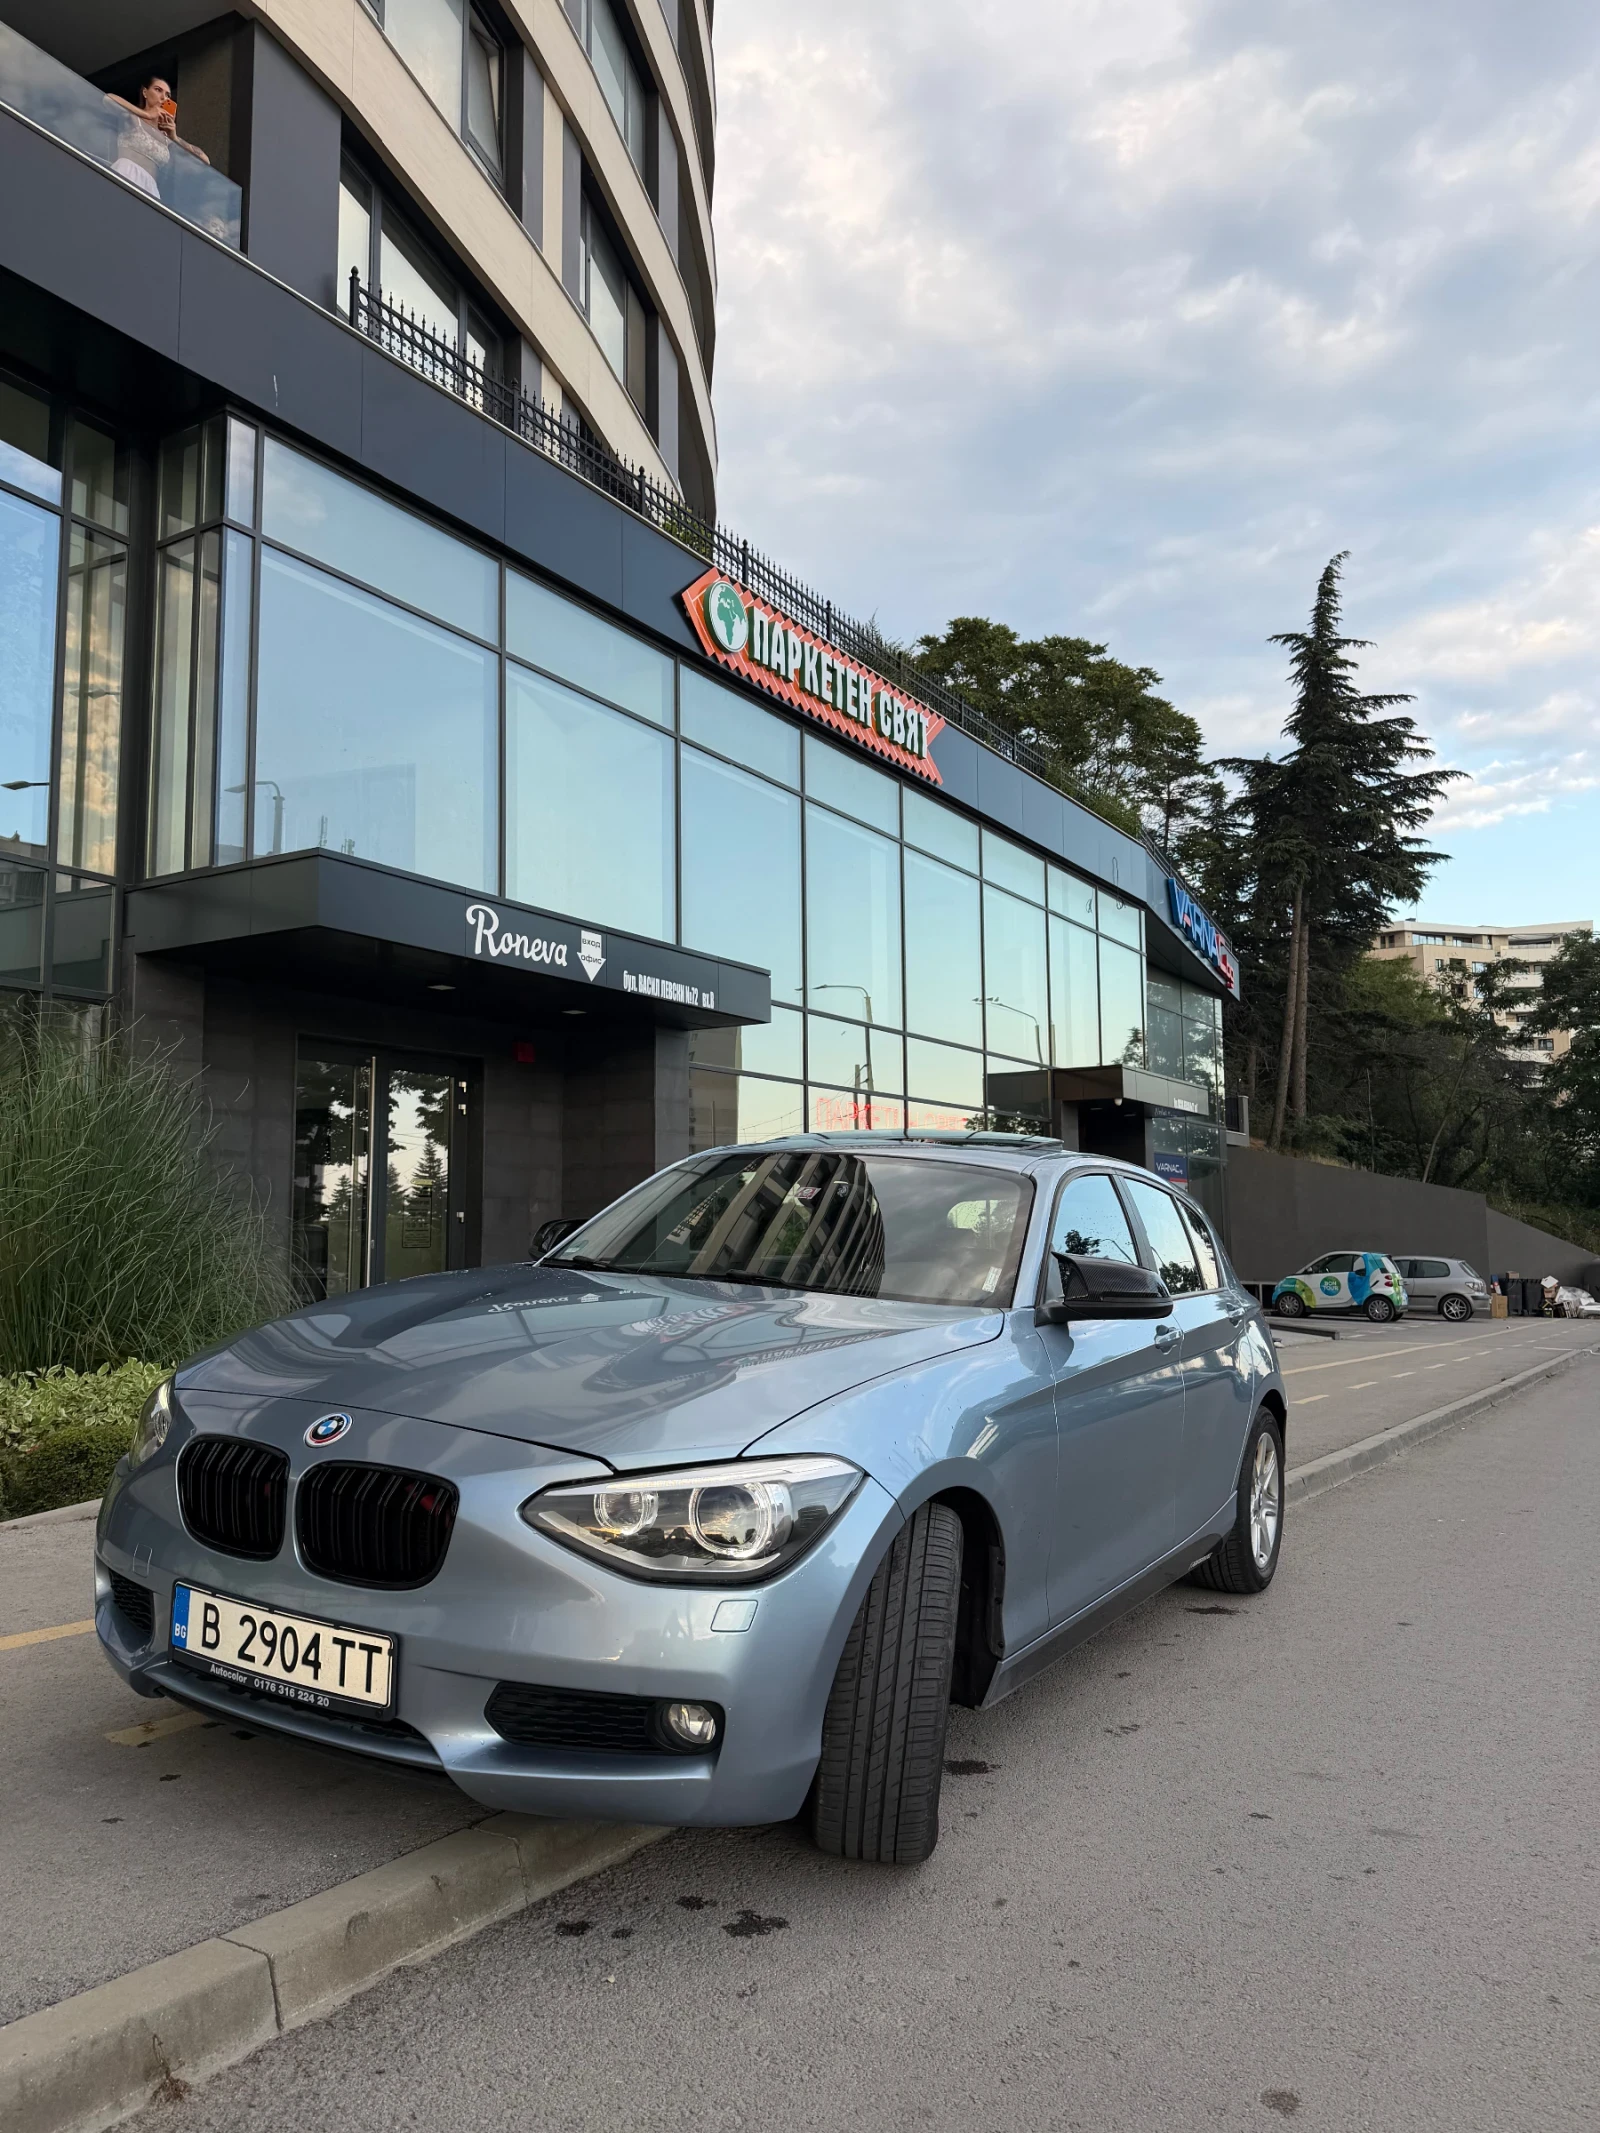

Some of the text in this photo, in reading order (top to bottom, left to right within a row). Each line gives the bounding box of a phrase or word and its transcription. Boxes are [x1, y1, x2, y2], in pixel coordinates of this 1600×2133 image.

[751, 606, 929, 760] ПАРКЕТЕН СВЯТ
[466, 904, 568, 967] Roneva
[582, 939, 601, 949] вход
[580, 954, 602, 965] офис
[623, 970, 638, 992] бул.
[638, 973, 660, 997] ВАСИЛ
[660, 979, 685, 1003] ЛЕВСКИ
[175, 1622, 186, 1639] BG
[201, 1602, 383, 1694] B 2904 TT
[210, 1663, 330, 1707] Autocolor 0176 316 224 20
